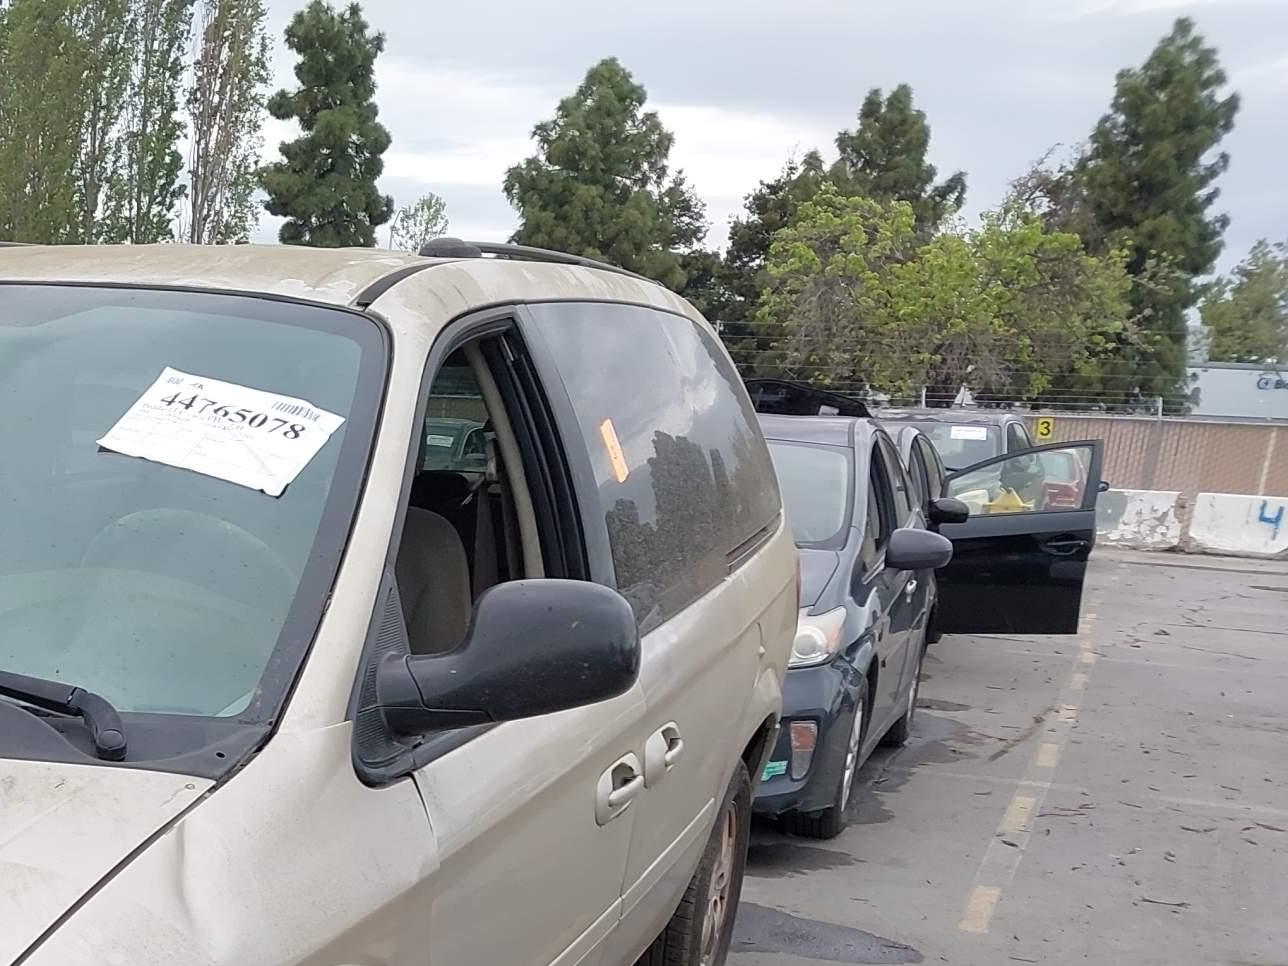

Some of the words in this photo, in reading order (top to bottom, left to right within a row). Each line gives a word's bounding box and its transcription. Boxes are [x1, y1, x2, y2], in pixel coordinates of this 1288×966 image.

[161, 391, 306, 440] 44765078
[1039, 420, 1052, 437] 3
[1259, 500, 1284, 541] 4
